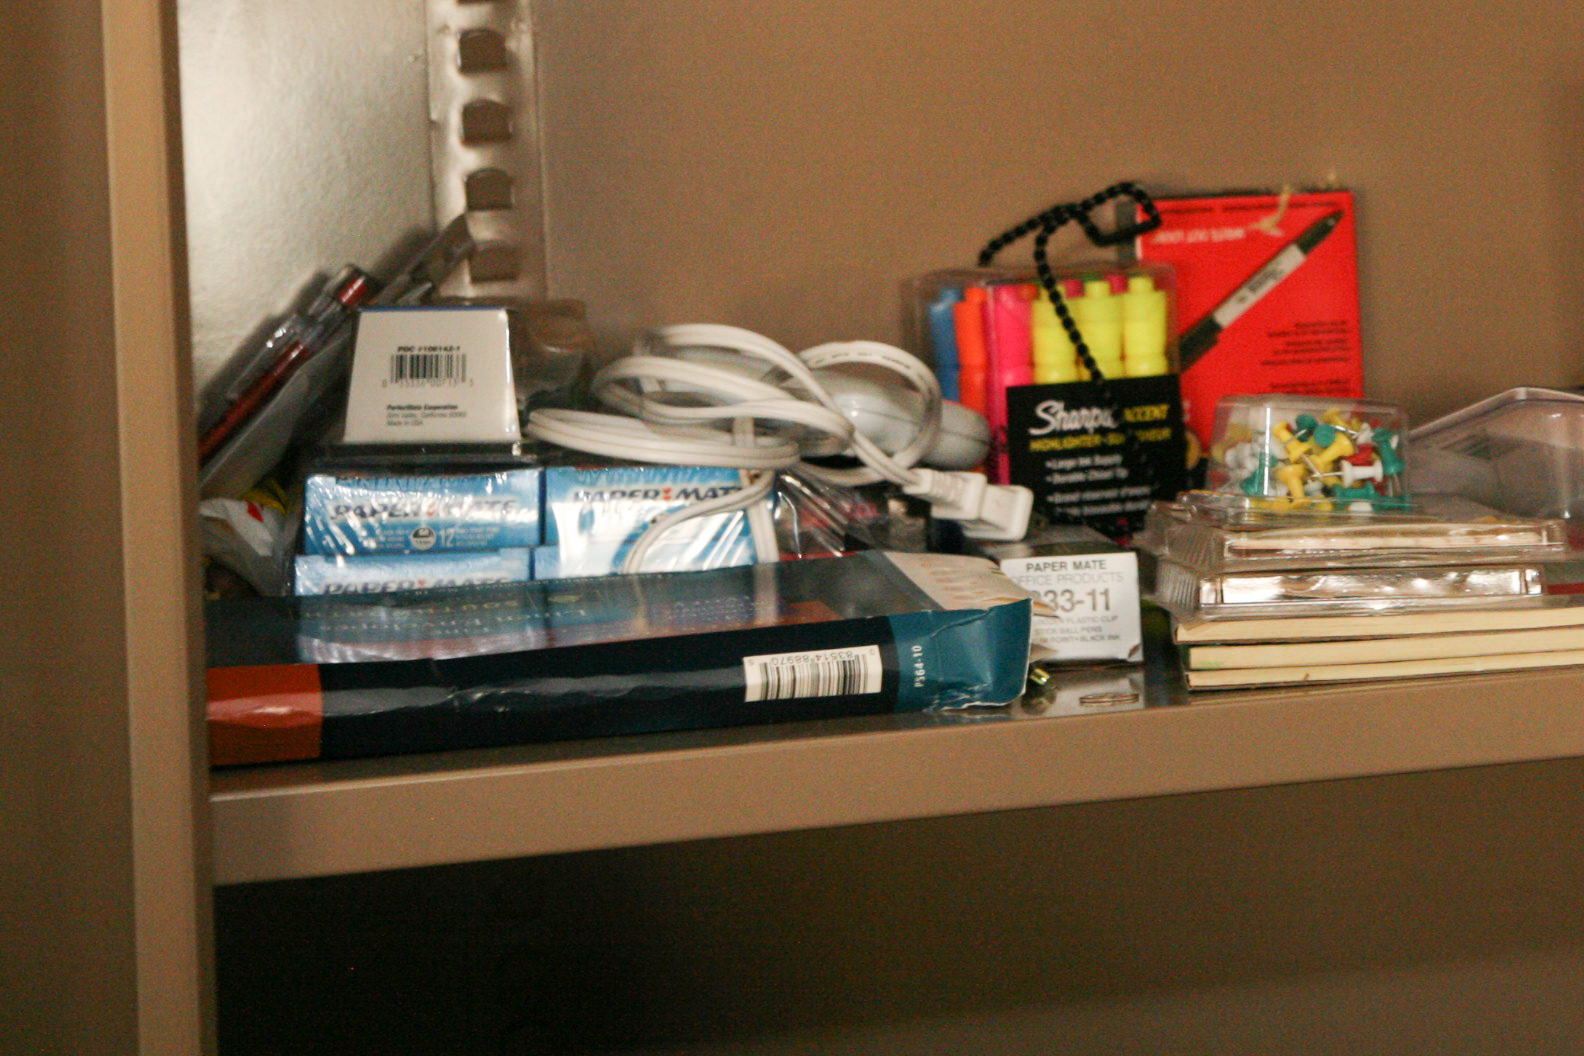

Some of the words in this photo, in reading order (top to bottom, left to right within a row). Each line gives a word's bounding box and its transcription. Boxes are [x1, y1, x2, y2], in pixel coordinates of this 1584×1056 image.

[673, 485, 743, 501] MAT
[1026, 562, 1067, 572] PAPER
[1073, 560, 1107, 570] MATE
[1057, 571, 1124, 584] PRODUCTS
[771, 654, 810, 667] 88970
[815, 651, 853, 663] 83514
